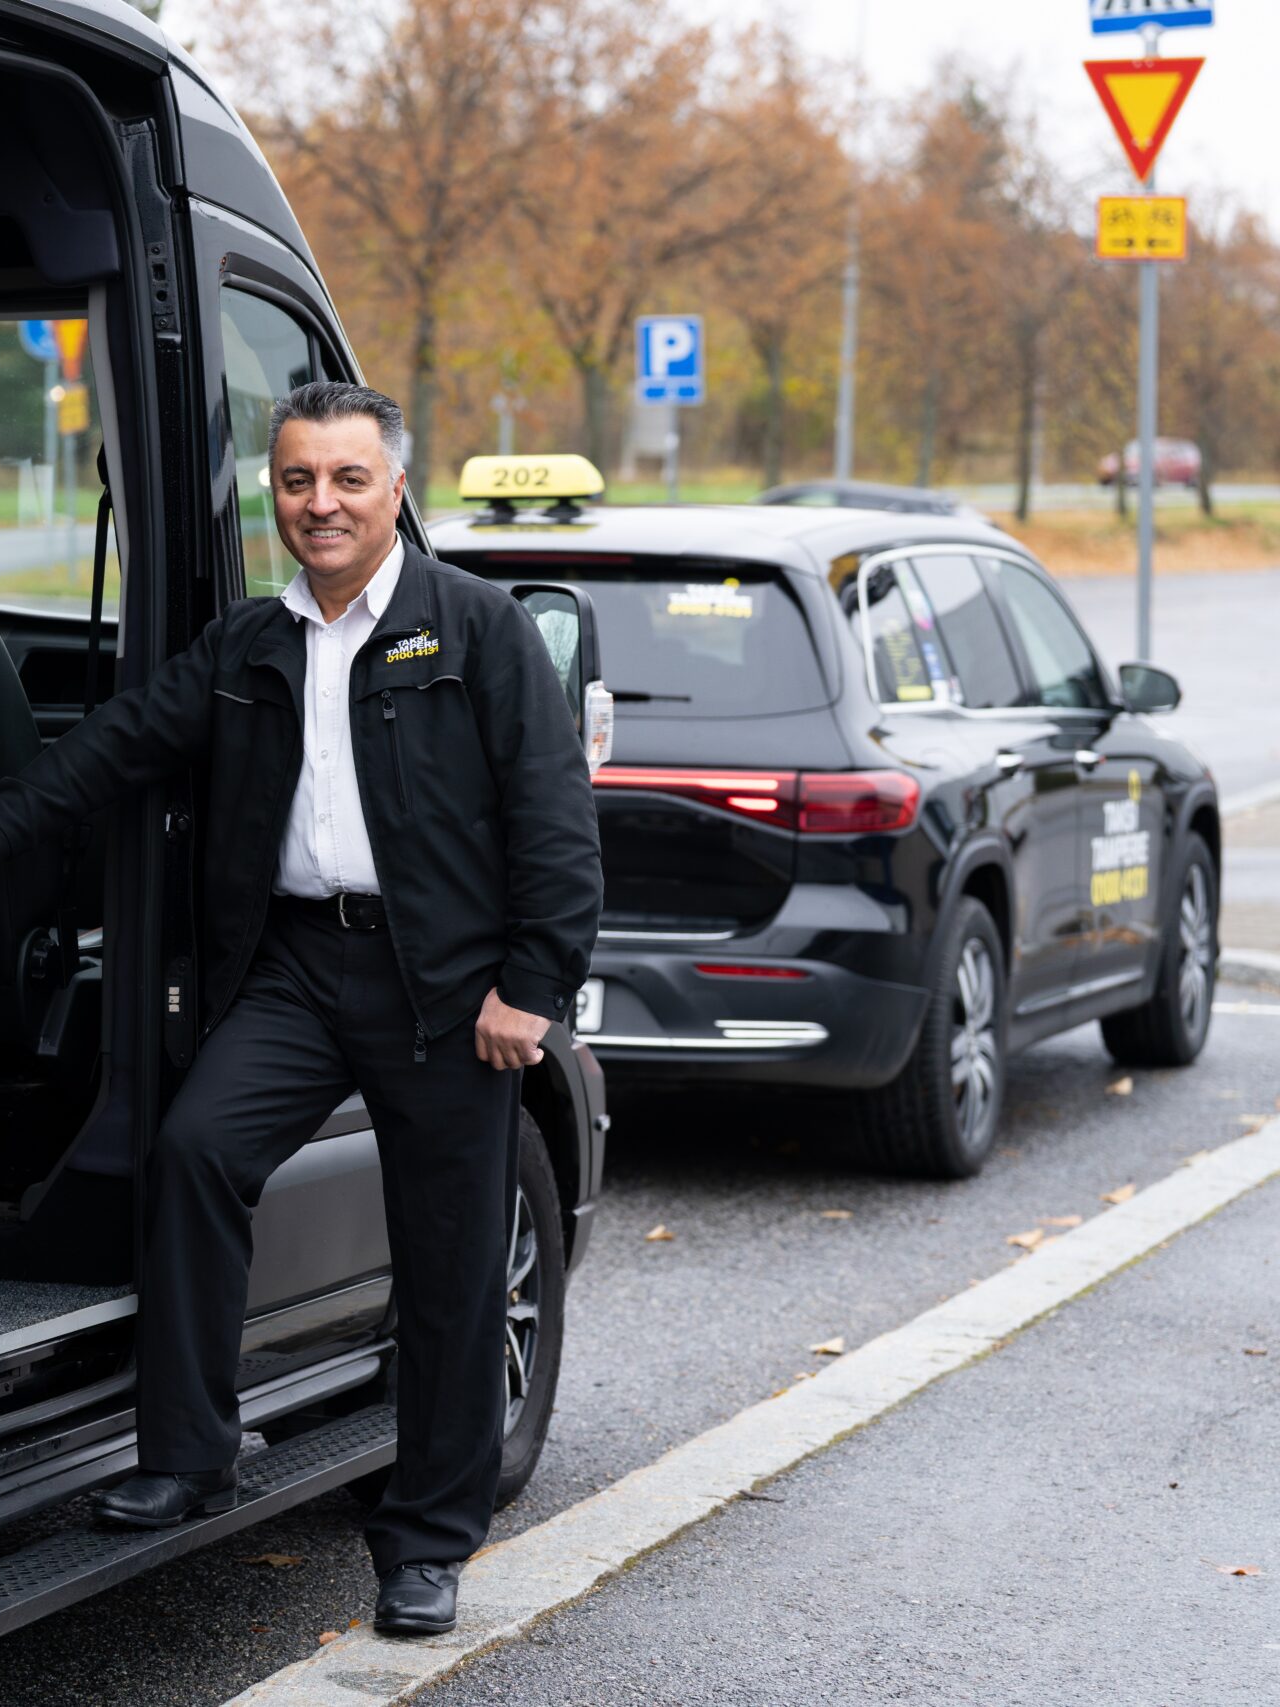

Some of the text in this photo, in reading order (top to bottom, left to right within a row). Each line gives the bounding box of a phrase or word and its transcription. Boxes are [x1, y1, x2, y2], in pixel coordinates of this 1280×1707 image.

[651, 322, 693, 380] P
[494, 467, 549, 487] 202
[385, 638, 439, 657] TAMPERE
[395, 635, 428, 647] TAKSI
[386, 645, 439, 663] 0100 4131
